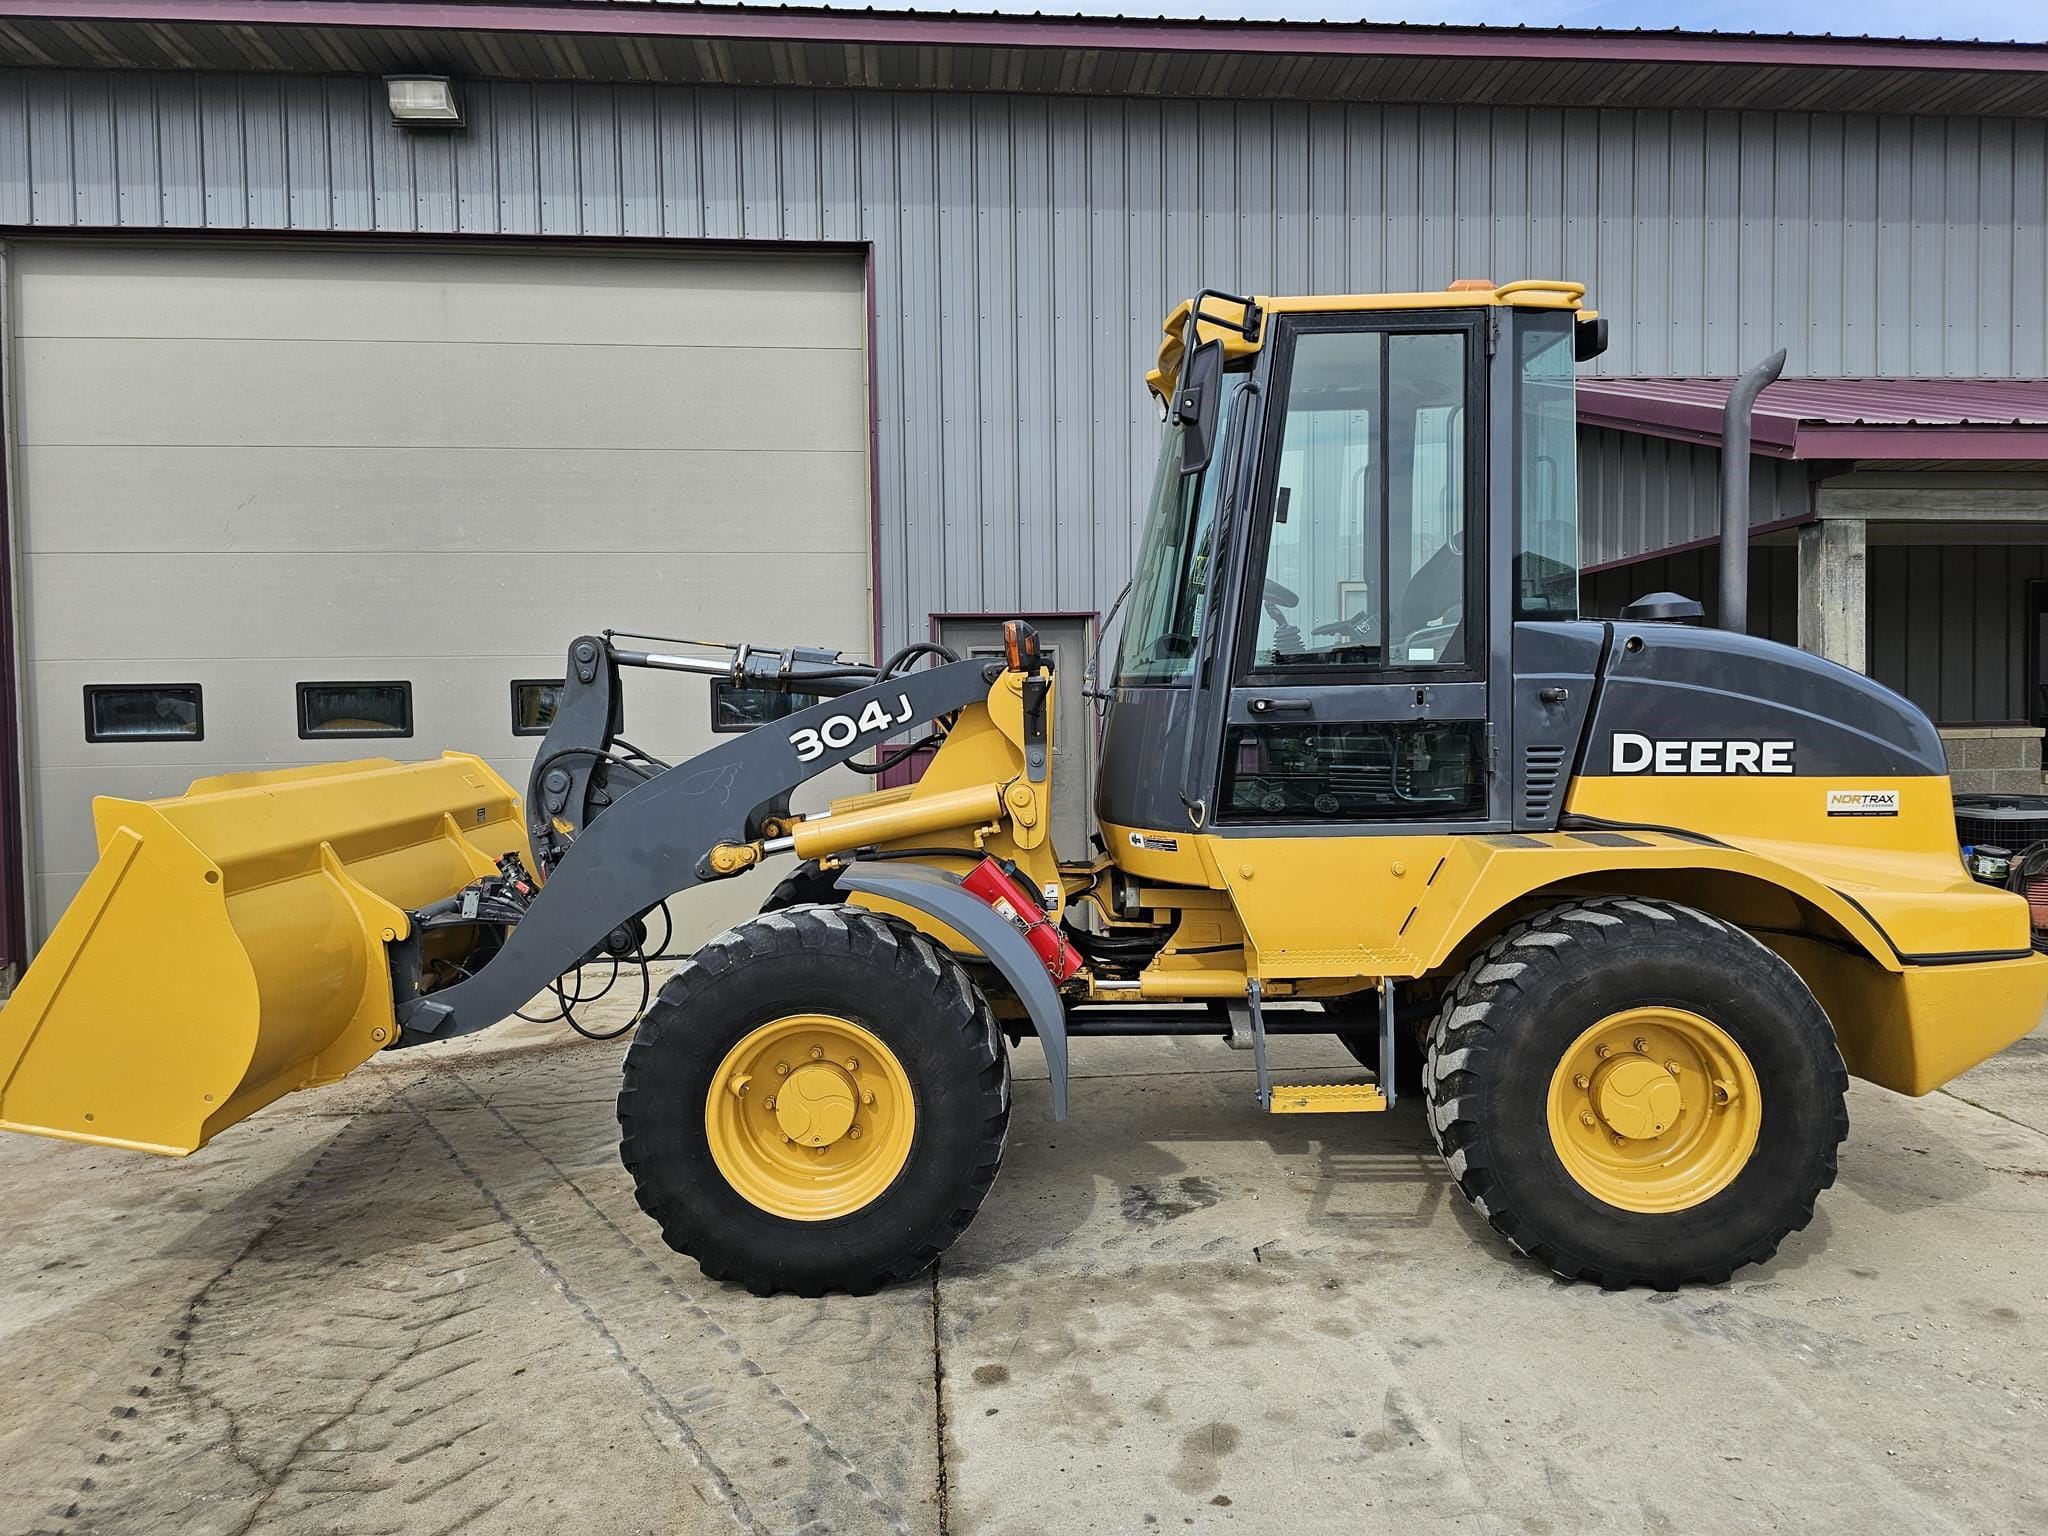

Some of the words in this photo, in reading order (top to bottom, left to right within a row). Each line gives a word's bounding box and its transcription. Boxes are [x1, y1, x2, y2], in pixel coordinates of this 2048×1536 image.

[788, 693, 914, 762] 304J
[1612, 733, 1795, 774] DEERE
[1831, 794, 1895, 805] NORTRAX
